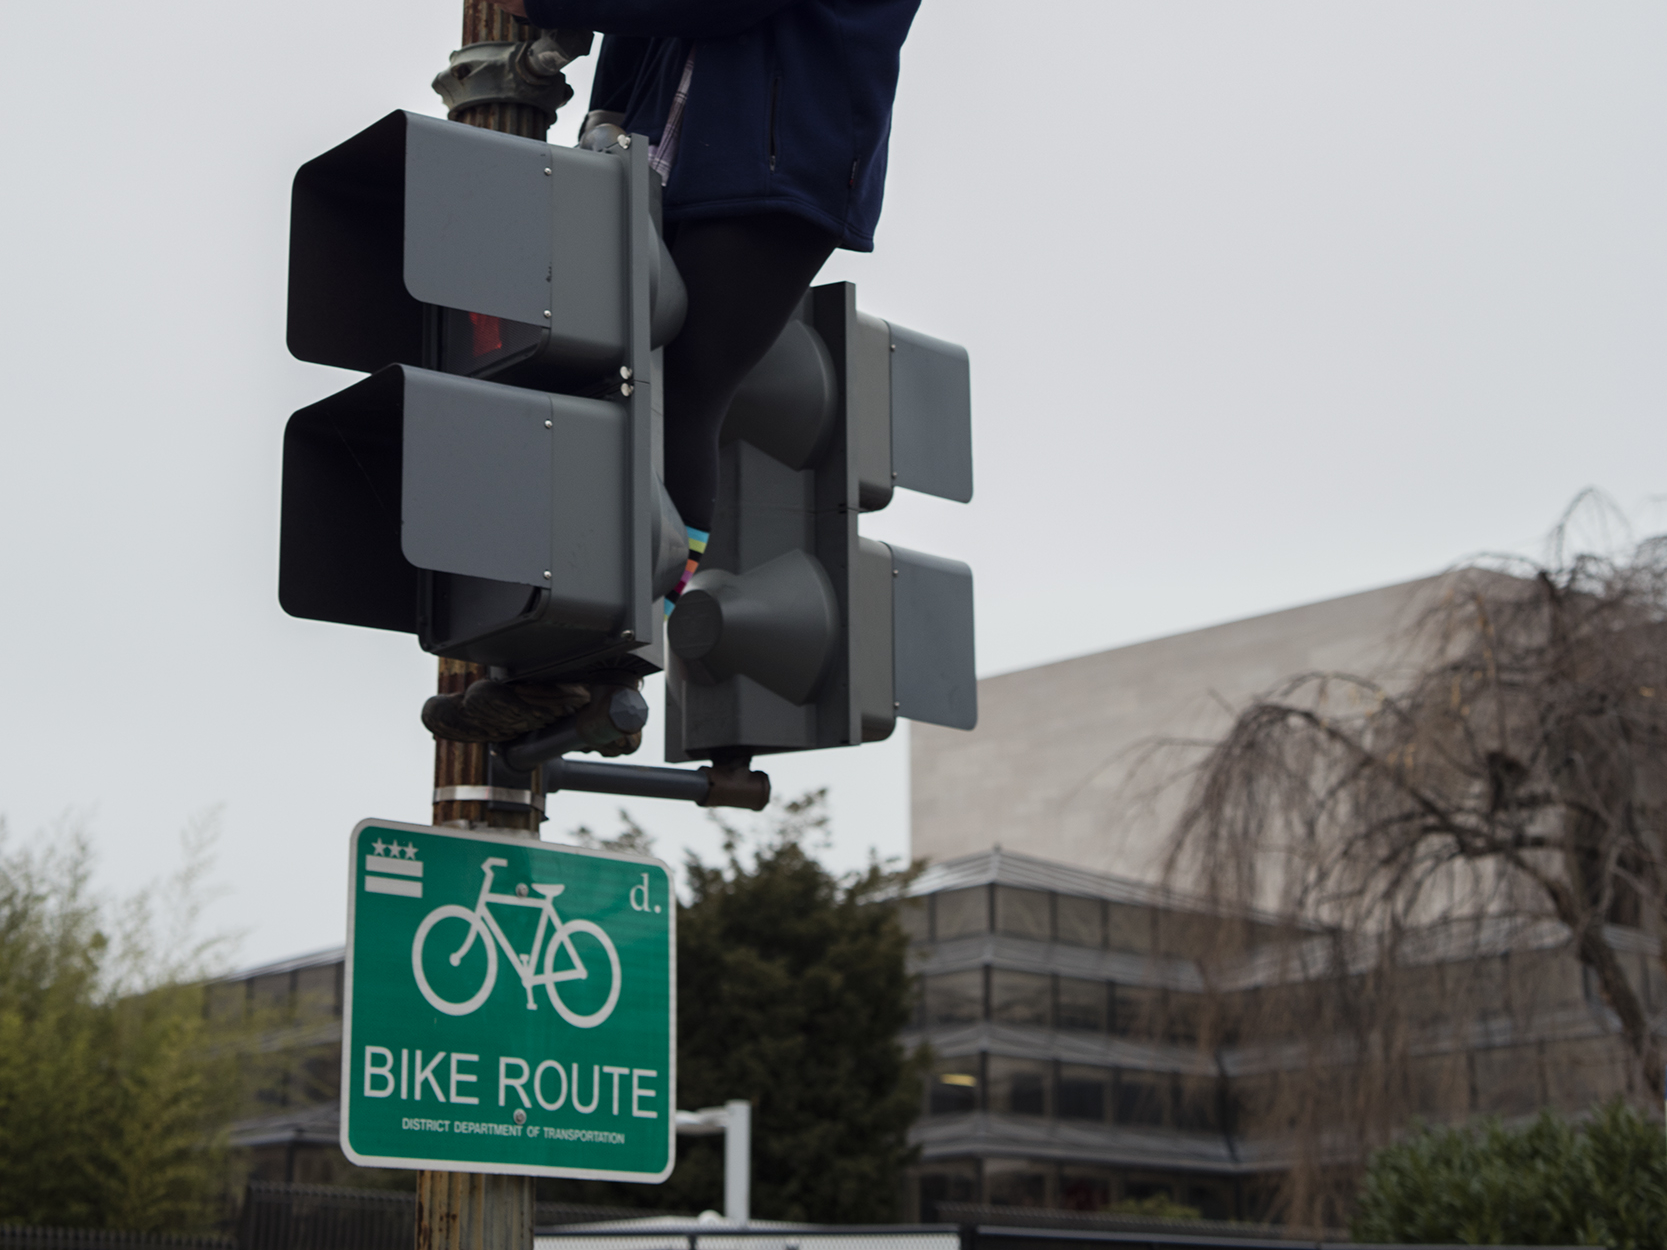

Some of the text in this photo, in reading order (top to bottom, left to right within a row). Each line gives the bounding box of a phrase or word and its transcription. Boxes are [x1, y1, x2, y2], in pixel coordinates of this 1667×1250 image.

[630, 872, 662, 914] d.
[364, 1046, 658, 1119] BIKE ROUTE
[402, 1117, 625, 1144] DISTRICT DEPARTMENT OF TRANSPORTATION
